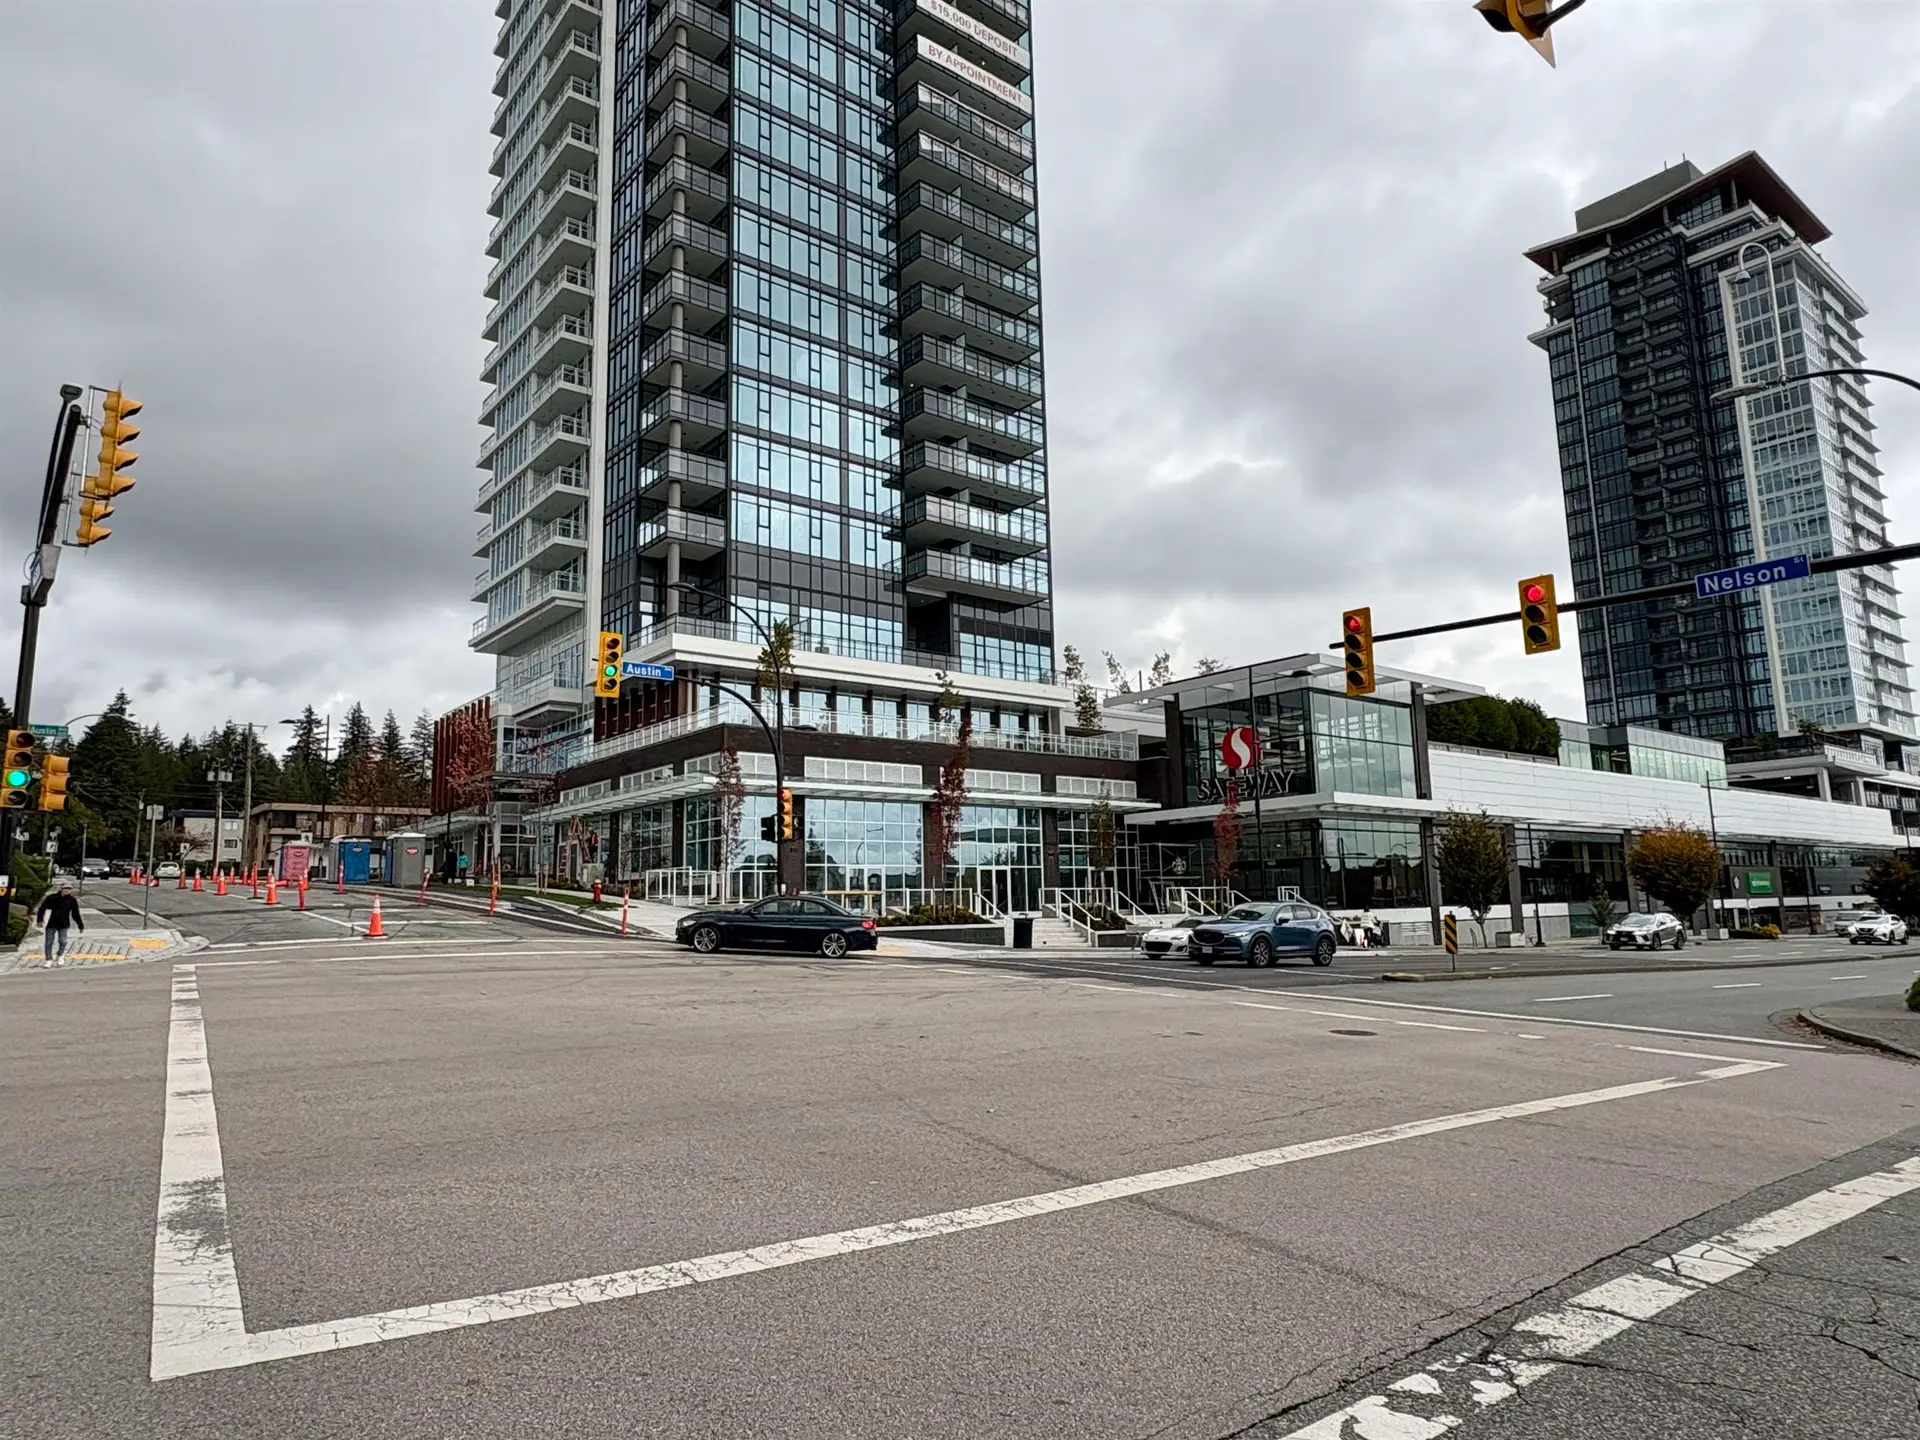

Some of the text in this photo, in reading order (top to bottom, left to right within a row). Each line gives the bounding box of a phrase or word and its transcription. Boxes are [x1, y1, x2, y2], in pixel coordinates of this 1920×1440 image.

[930, 0, 1018, 58] $15,000 DEPOSIT
[928, 44, 1023, 104] BY APPOINTMENT
[1703, 556, 1804, 594] Nelson St
[626, 663, 662, 677] Austin
[31, 725, 57, 735] Austin
